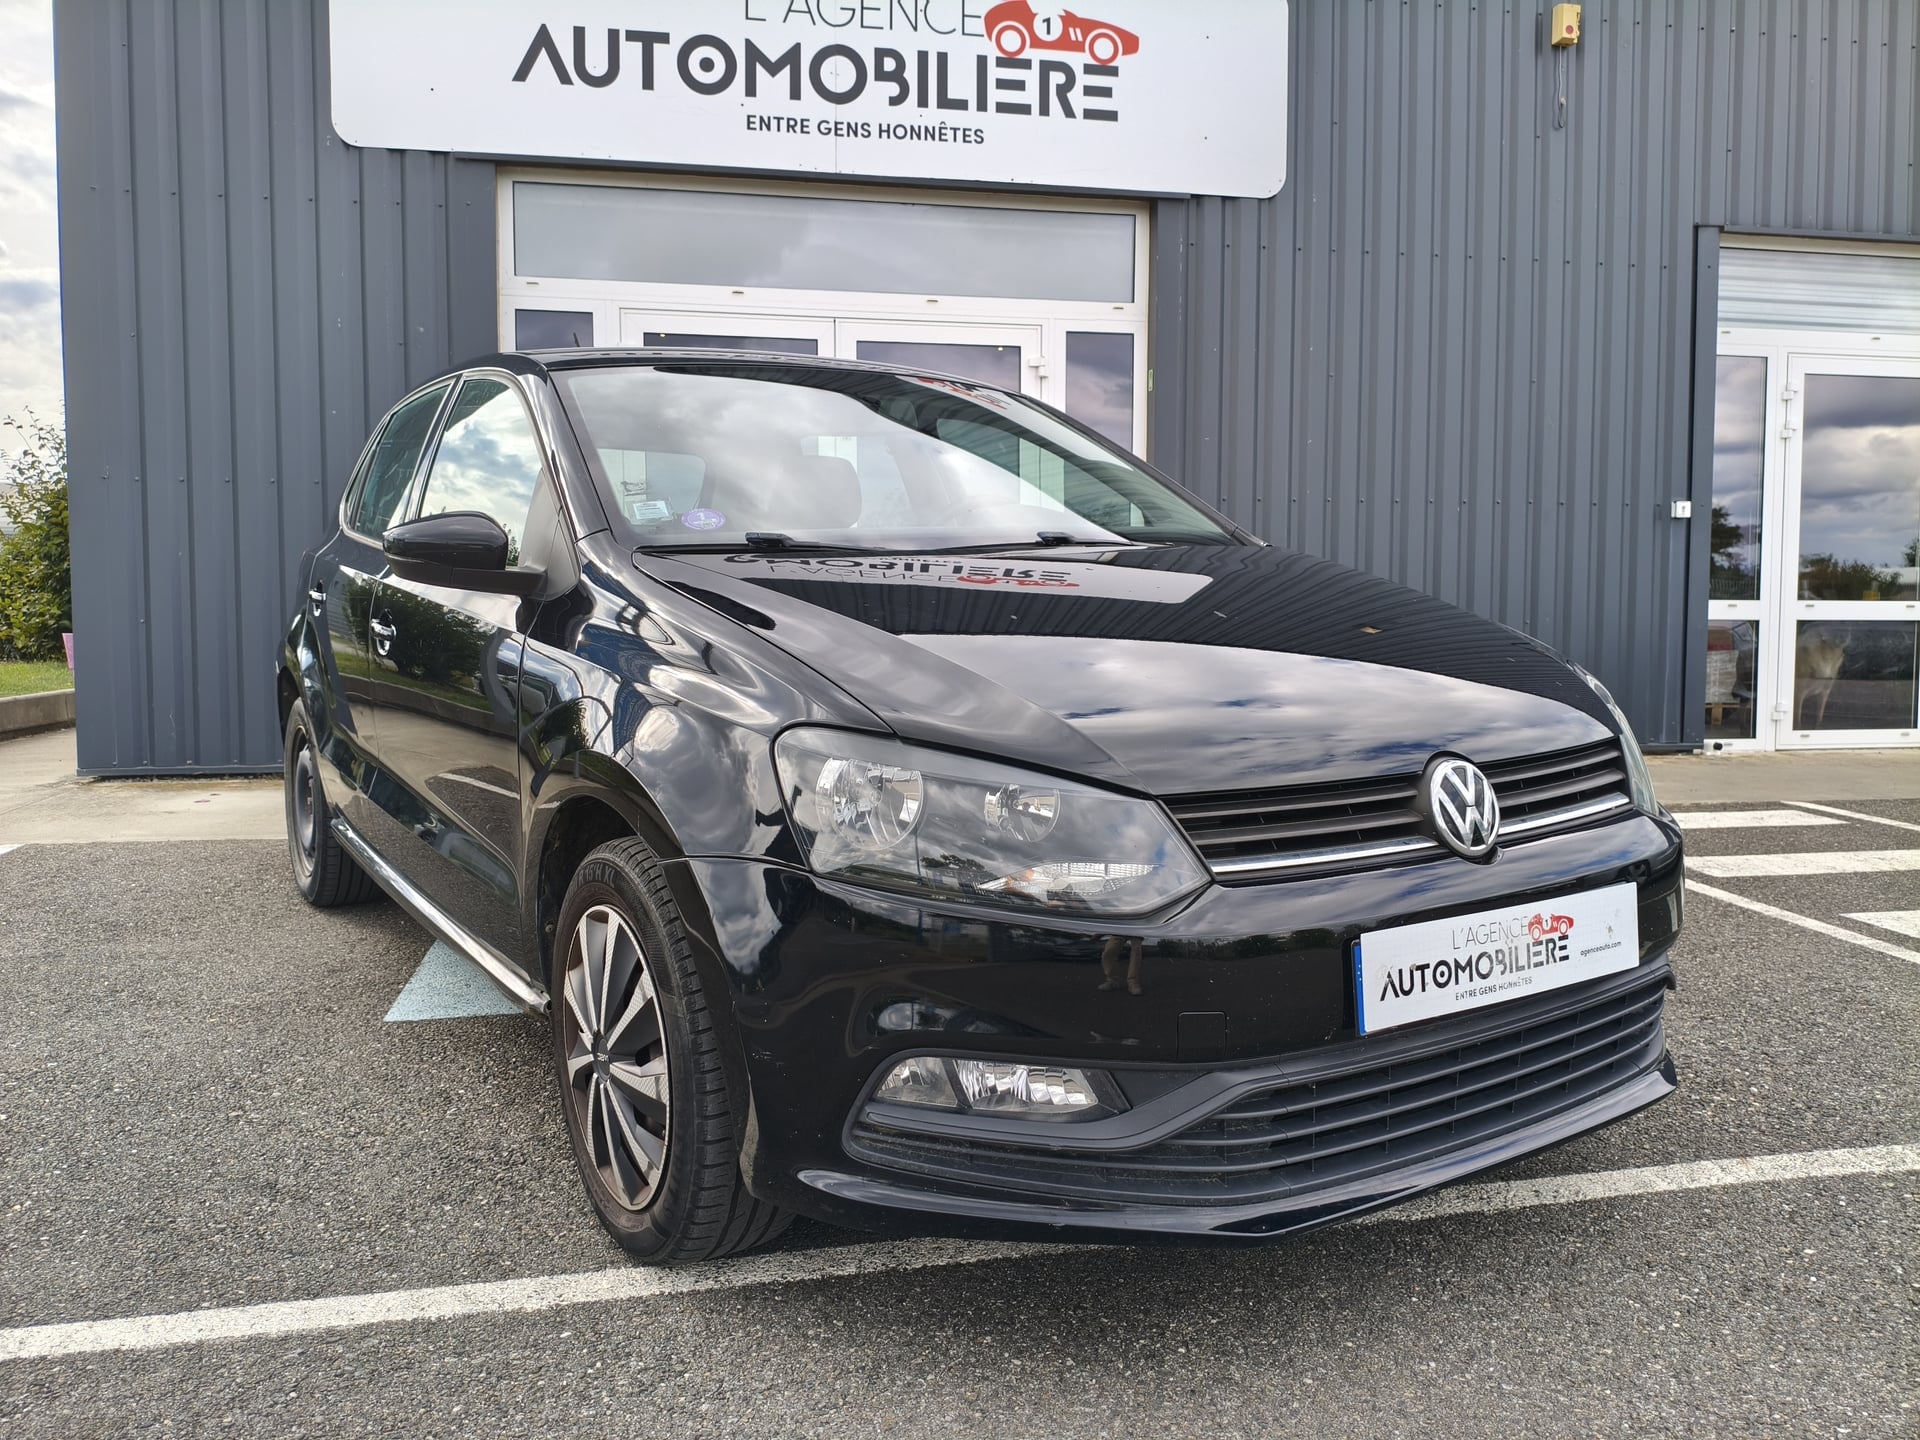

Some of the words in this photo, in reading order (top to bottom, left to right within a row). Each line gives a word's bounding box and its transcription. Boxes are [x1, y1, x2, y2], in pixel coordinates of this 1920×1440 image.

[745, 0, 985, 37] LAGENCE
[1042, 16, 1051, 36] 1
[511, 23, 1119, 122] AUTOMOBILIERE
[746, 114, 811, 135] ENTRE
[817, 119, 872, 139] GENS
[878, 121, 985, 145] HONNÊTES
[1431, 760, 1500, 851] VW
[1452, 916, 1528, 950] L'AGENCE
[1380, 934, 1570, 1002] AUTOMOBILIERE
[1455, 988, 1477, 1001] ENTRE
[1479, 984, 1497, 996] GENS
